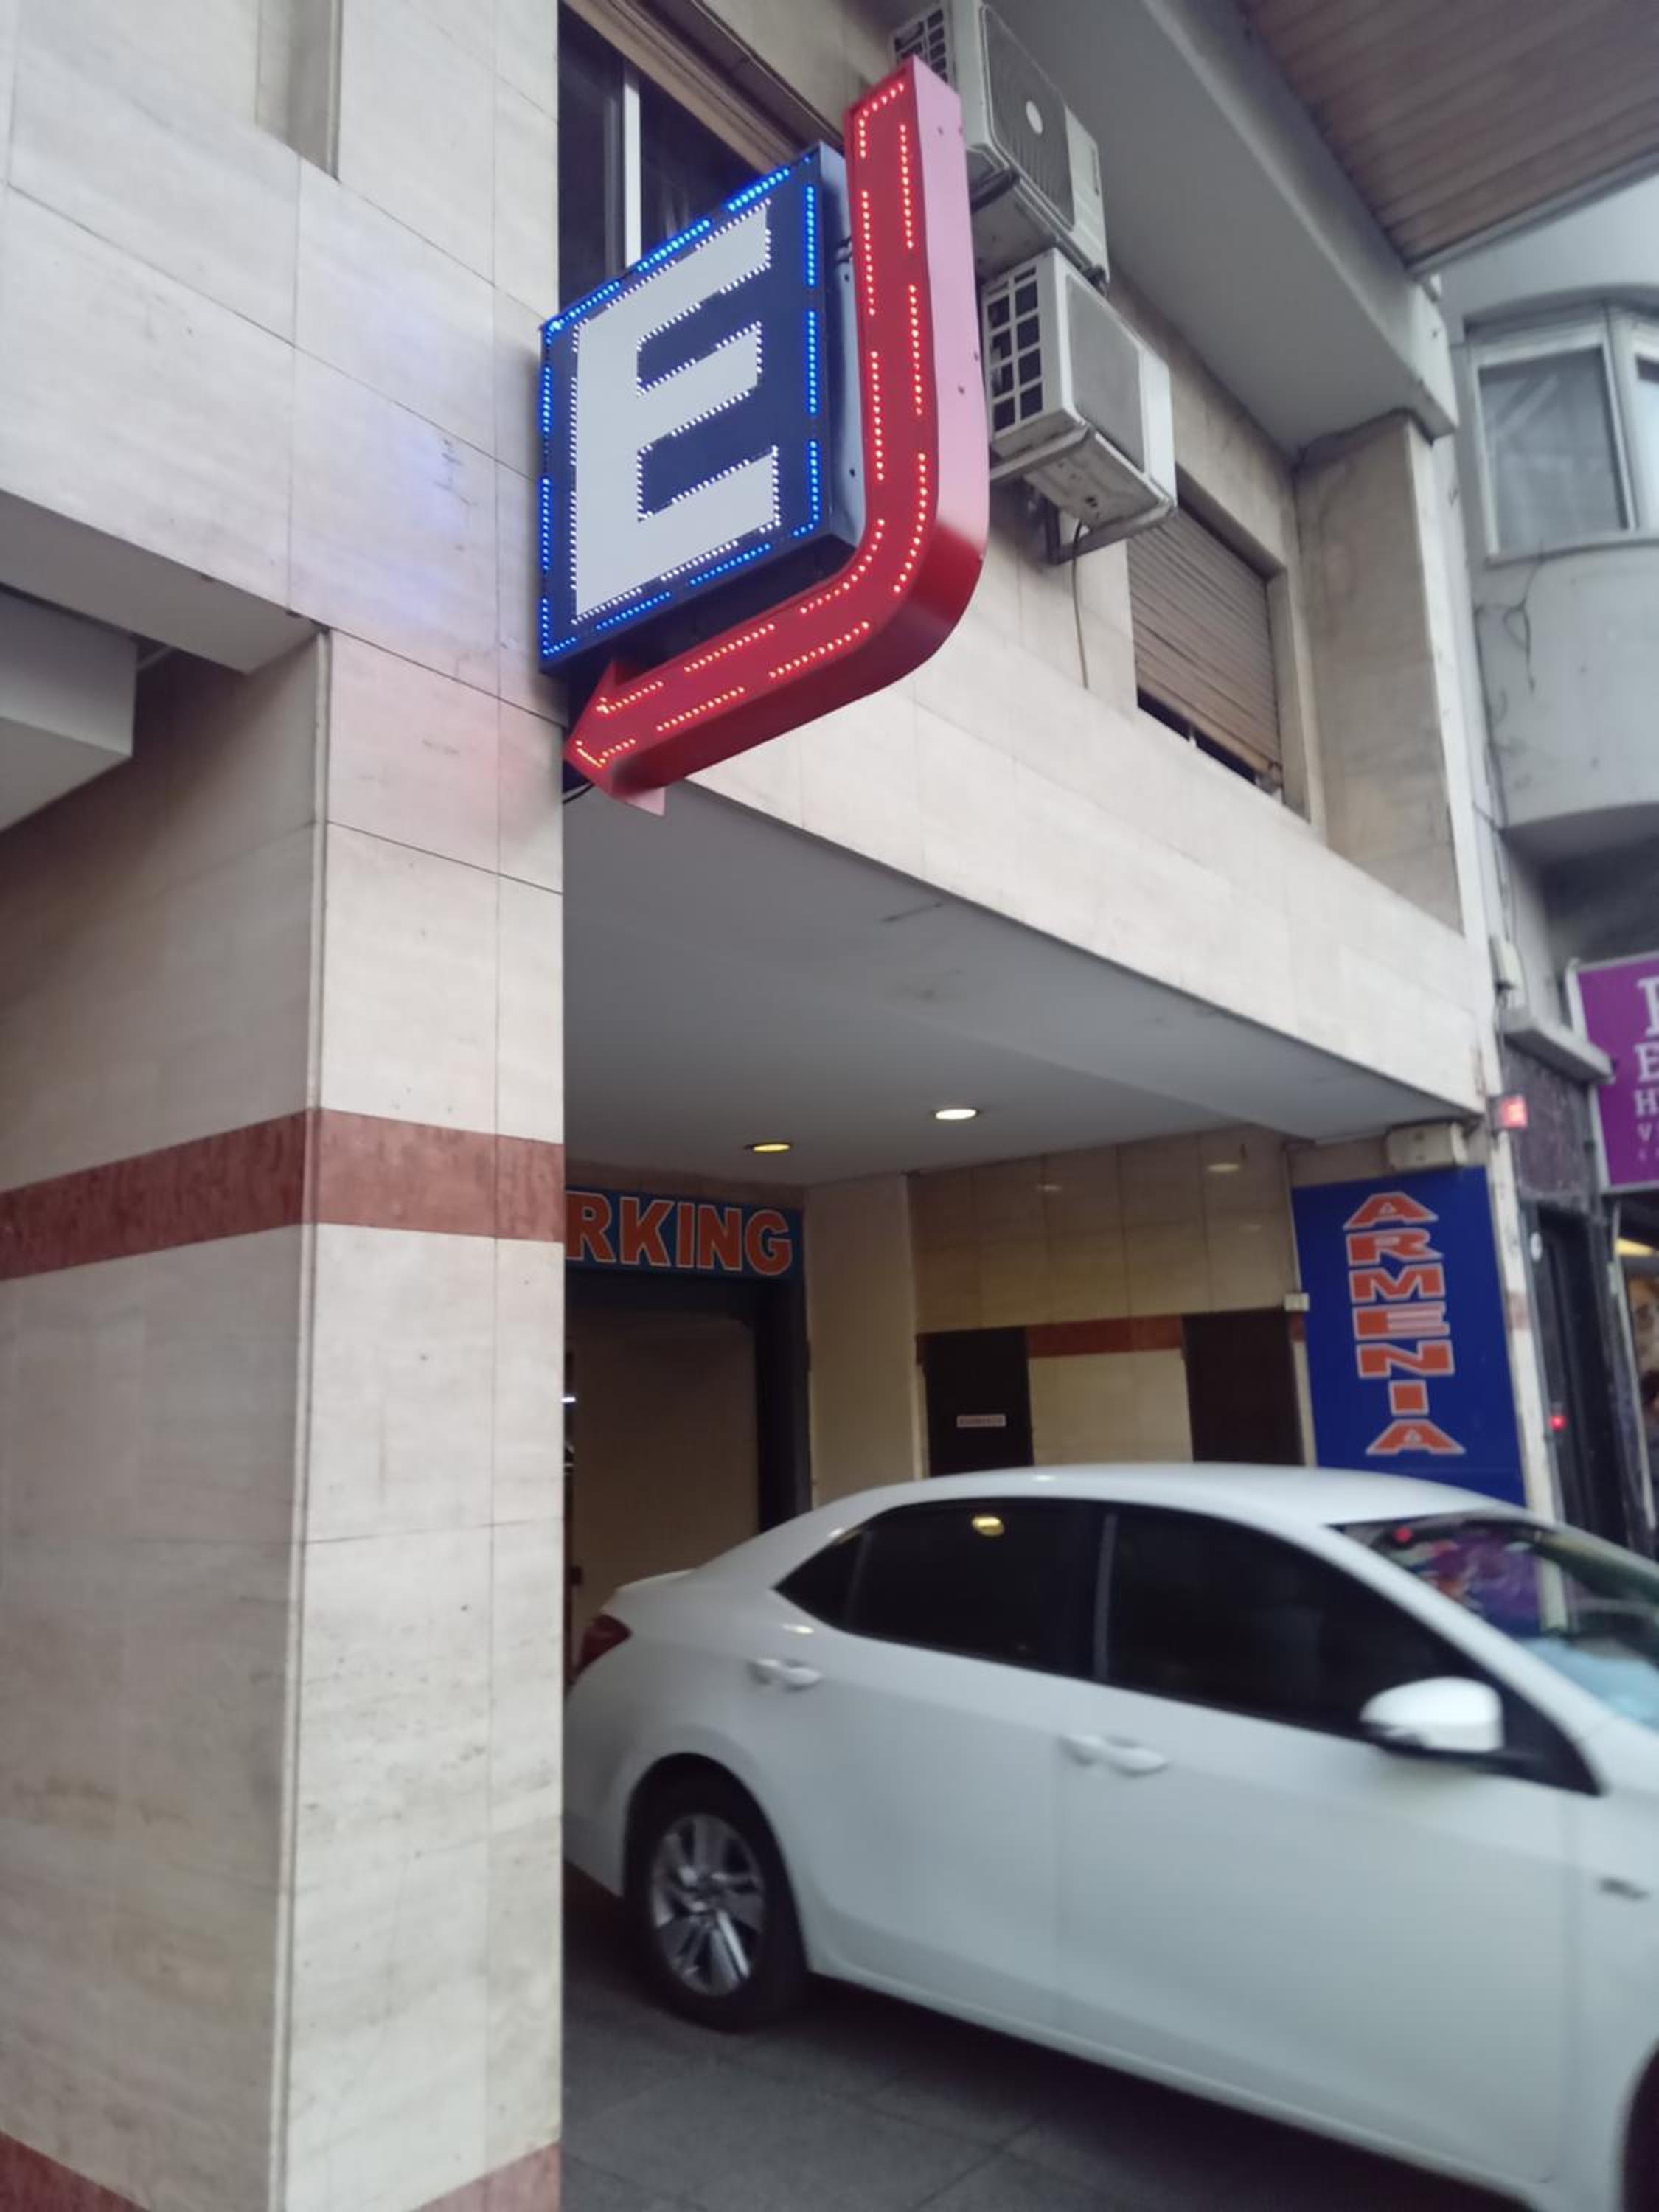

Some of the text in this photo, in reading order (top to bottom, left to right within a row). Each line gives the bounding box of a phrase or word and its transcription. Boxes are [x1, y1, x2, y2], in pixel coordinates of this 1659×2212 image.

[571, 199, 779, 624] E
[566, 1190, 793, 1276] RKING
[1343, 1191, 1466, 1455] ARMENIA
